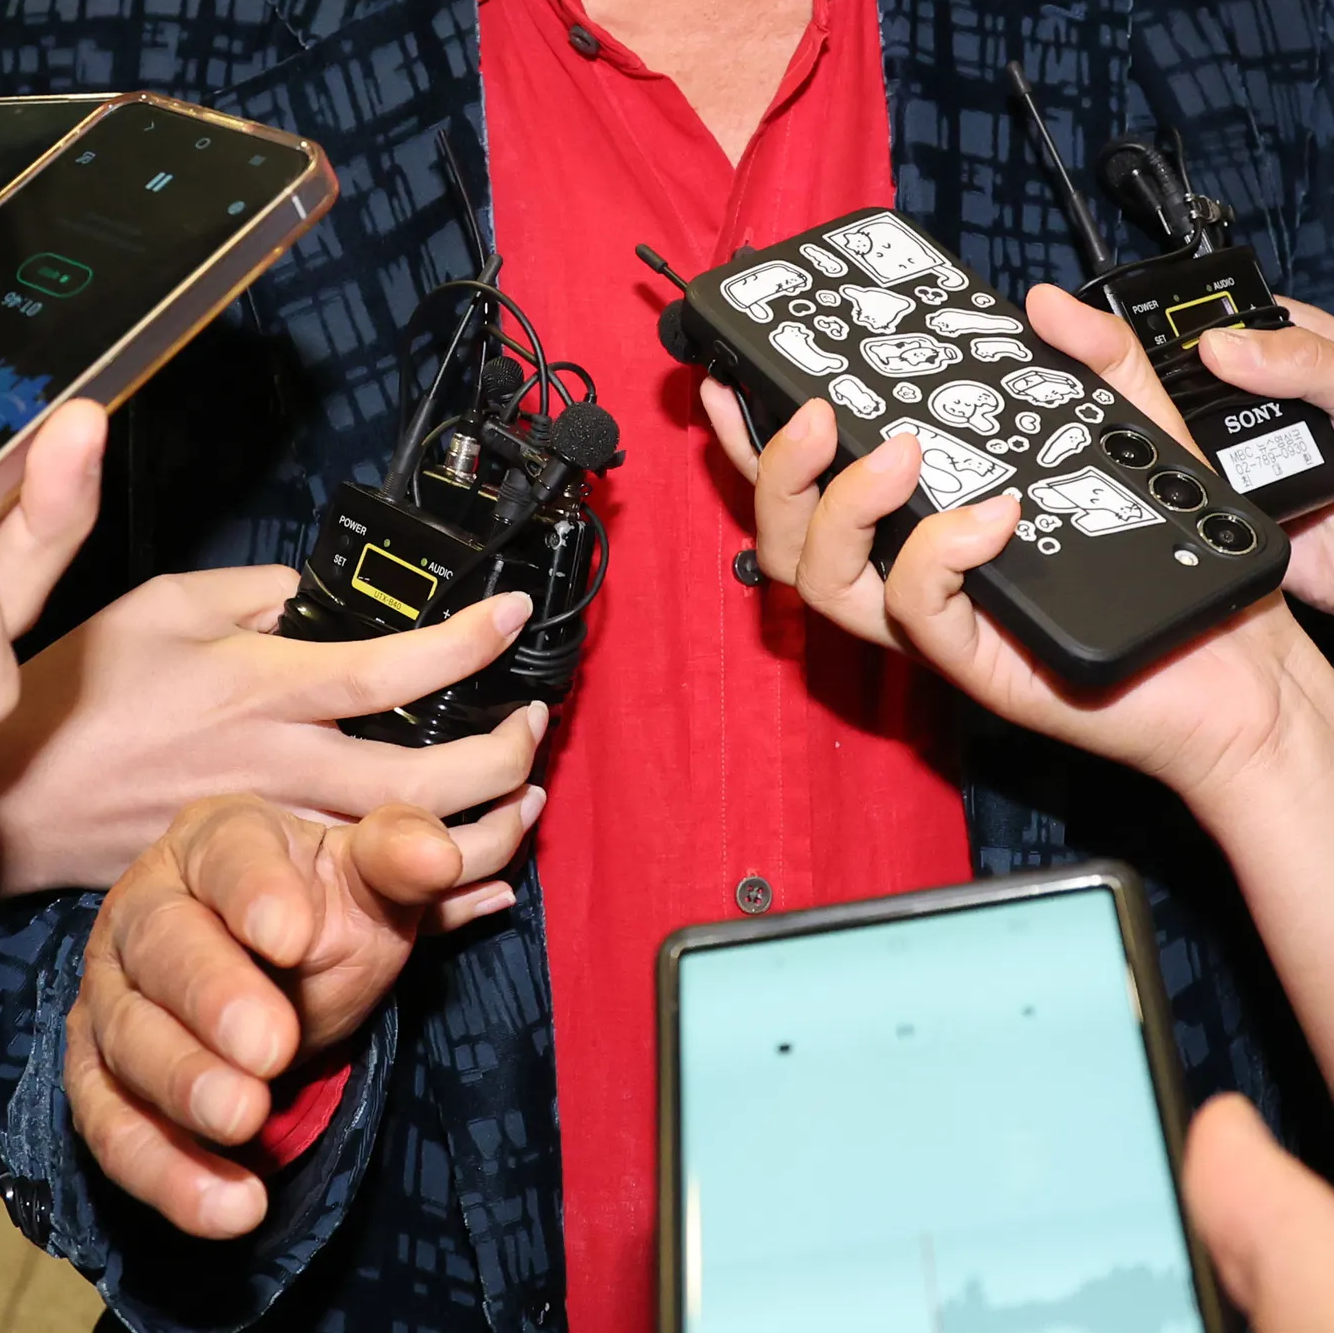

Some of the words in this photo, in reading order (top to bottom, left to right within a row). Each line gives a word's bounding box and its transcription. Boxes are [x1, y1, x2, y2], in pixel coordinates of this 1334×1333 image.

[1213, 277, 1235, 291] AUDIO
[1132, 299, 1159, 315] POWER
[1154, 334, 1166, 346] SET
[1224, 402, 1283, 434] SONY
[1230, 446, 1254, 464] MBC
[1256, 428, 1303, 455] 뉴스영상국
[1235, 441, 1308, 476] 02-789-0930
[339, 515, 367, 536] POWER
[333, 553, 348, 567] SET
[373, 590, 402, 611] UTX-B40
